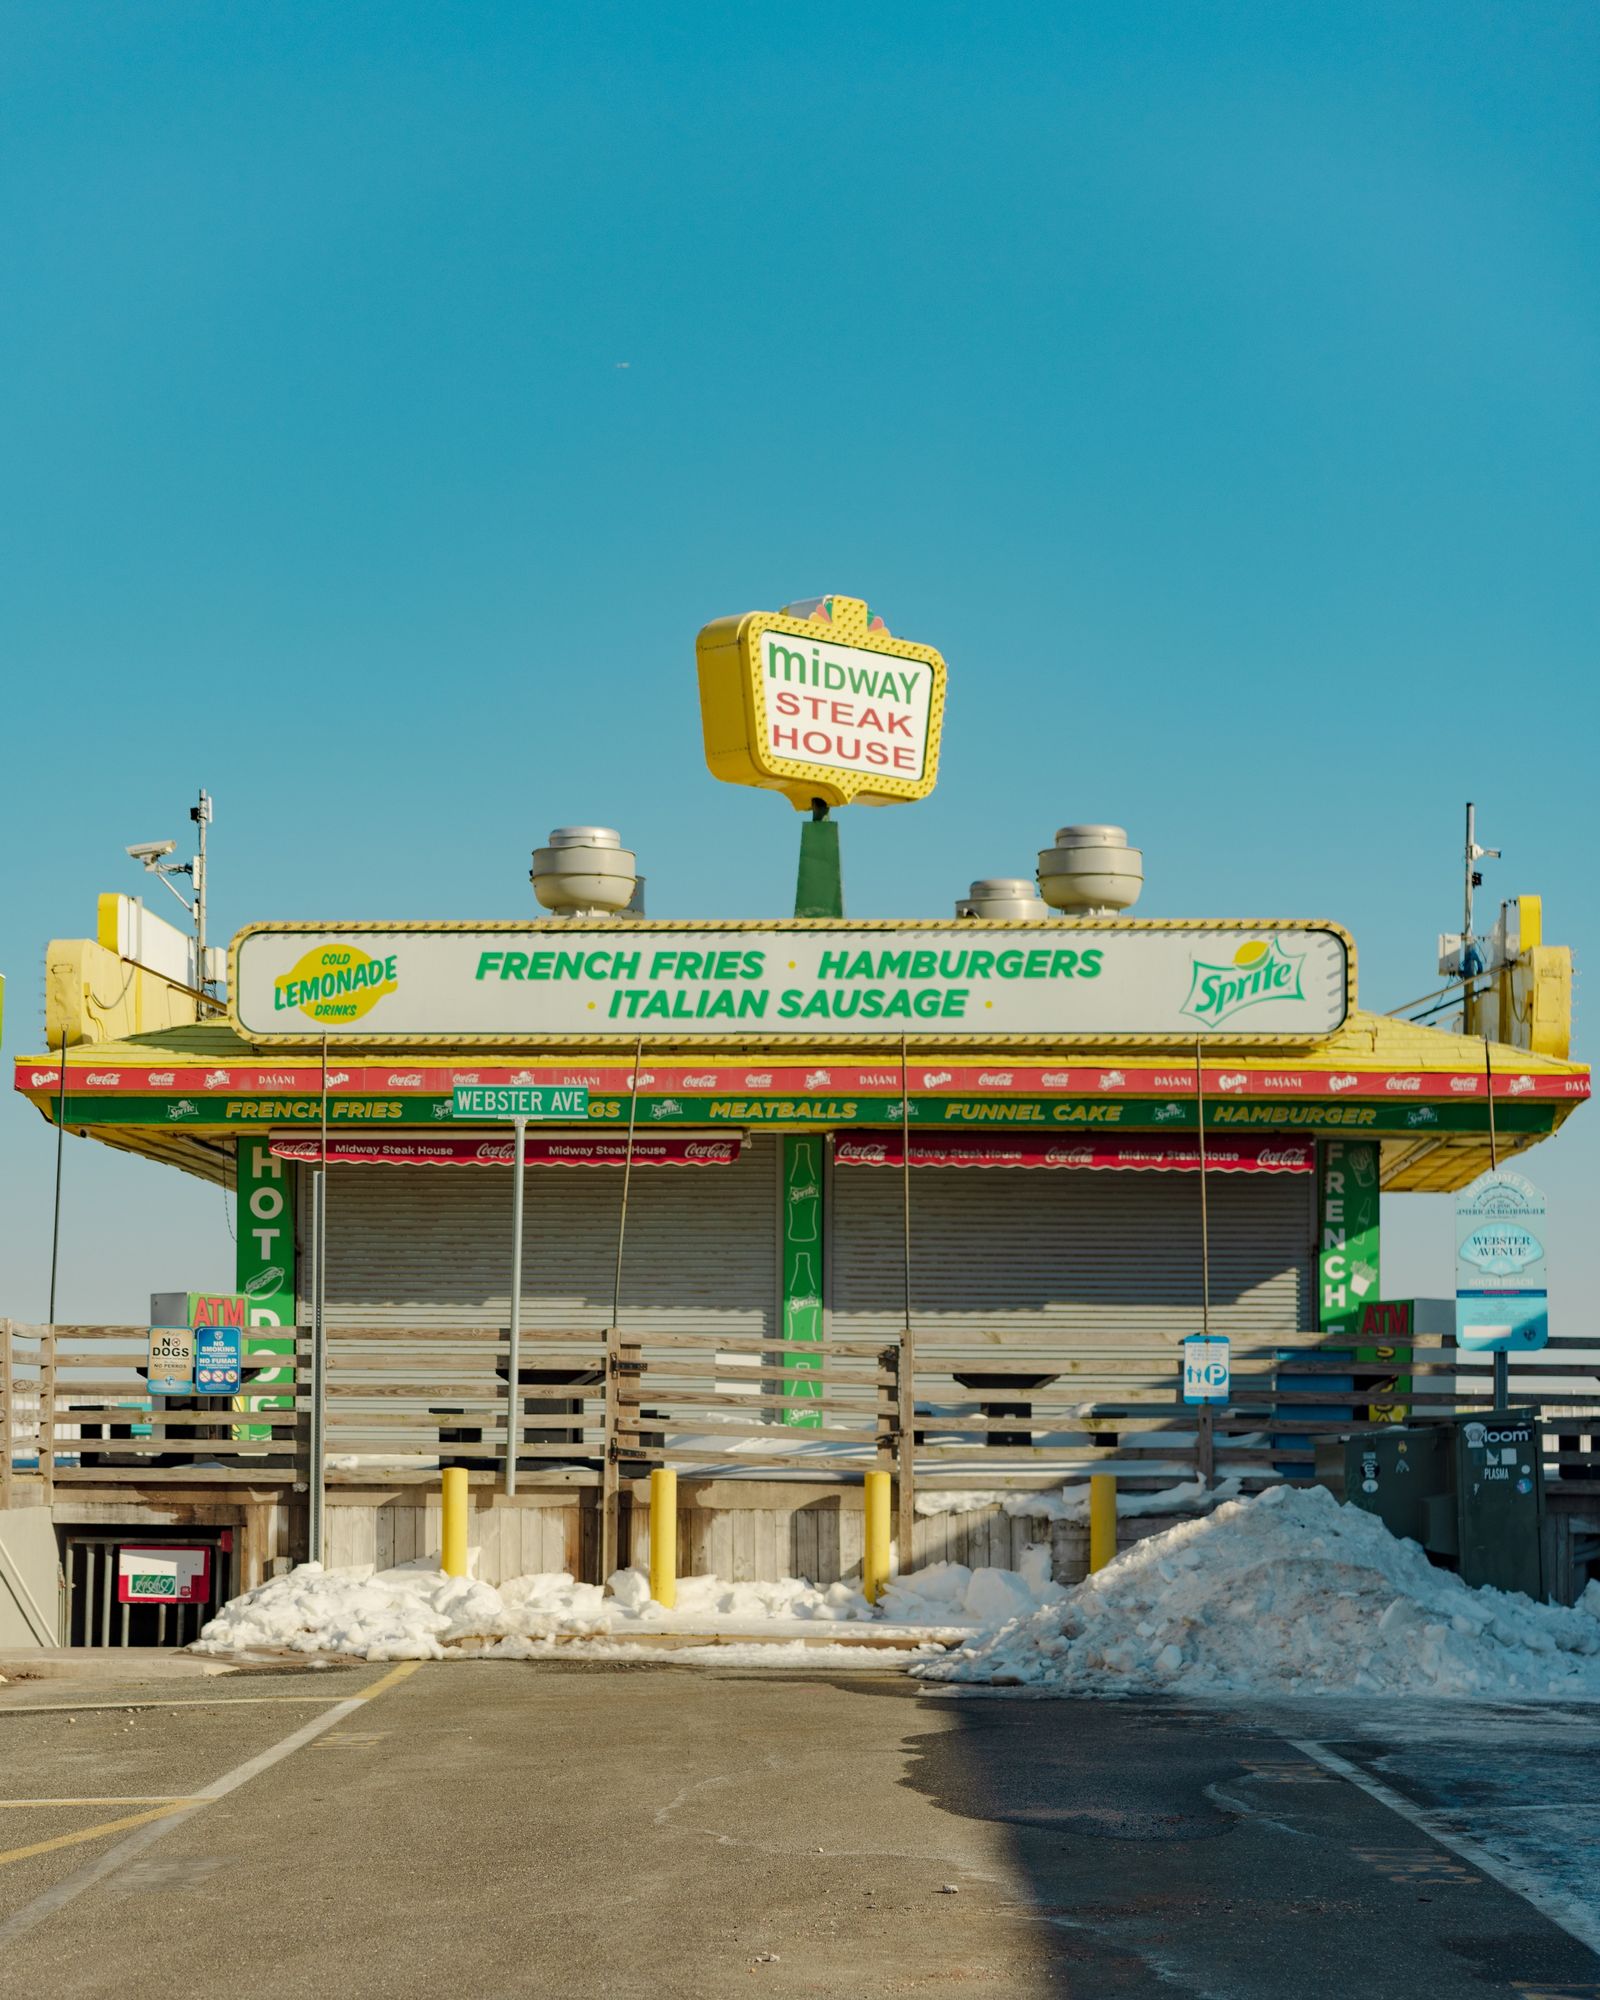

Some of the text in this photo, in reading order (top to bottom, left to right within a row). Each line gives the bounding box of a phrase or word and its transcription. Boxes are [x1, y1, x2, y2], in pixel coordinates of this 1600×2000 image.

[776, 692, 913, 738] STEAK
[773, 724, 916, 771] HOUSE
[321, 953, 351, 966] COLD
[475, 951, 767, 980] FRENCH FRIES
[817, 950, 1104, 980] HAMBURGERS
[274, 954, 397, 1011] LEMONADE
[1195, 956, 1291, 1016] Sprite
[314, 1004, 357, 1016] DRINKS
[608, 989, 969, 1018] ITALIAN SAUSAGE
[258, 1075, 295, 1086] DASANI
[859, 1075, 897, 1086] DASANI
[1154, 1076, 1192, 1087] DASANI
[1264, 1077, 1302, 1087] DASANI
[1565, 1081, 1591, 1091] DASA
[457, 1091, 585, 1111] WEBSTER AVE
[226, 1102, 403, 1118] FRENCH FRIES
[588, 1101, 621, 1118] GS
[709, 1102, 858, 1118] MEATBALLS
[944, 1103, 1123, 1121] FUNNEL CAKE
[1213, 1107, 1376, 1124] HAMBURGER
[335, 1144, 453, 1157] Midway Steak House
[477, 1142, 516, 1158] Coca-Col
[549, 1145, 667, 1157] Midway Steak House
[950, 1149, 984, 1158] Steak
[985, 1149, 1022, 1159] House
[1118, 1151, 1164, 1161] Midway
[1203, 1152, 1239, 1161] House
[249, 1146, 283, 1260] HOT
[1324, 1142, 1346, 1308] FRENCH
[1473, 1236, 1530, 1245] WEBSTER
[1477, 1247, 1526, 1256] AVENUE
[193, 1297, 246, 1328] ATM
[1361, 1304, 1409, 1337] ATM
[152, 1347, 190, 1357] DOGS
[1484, 1467, 1509, 1480] PLASMA
